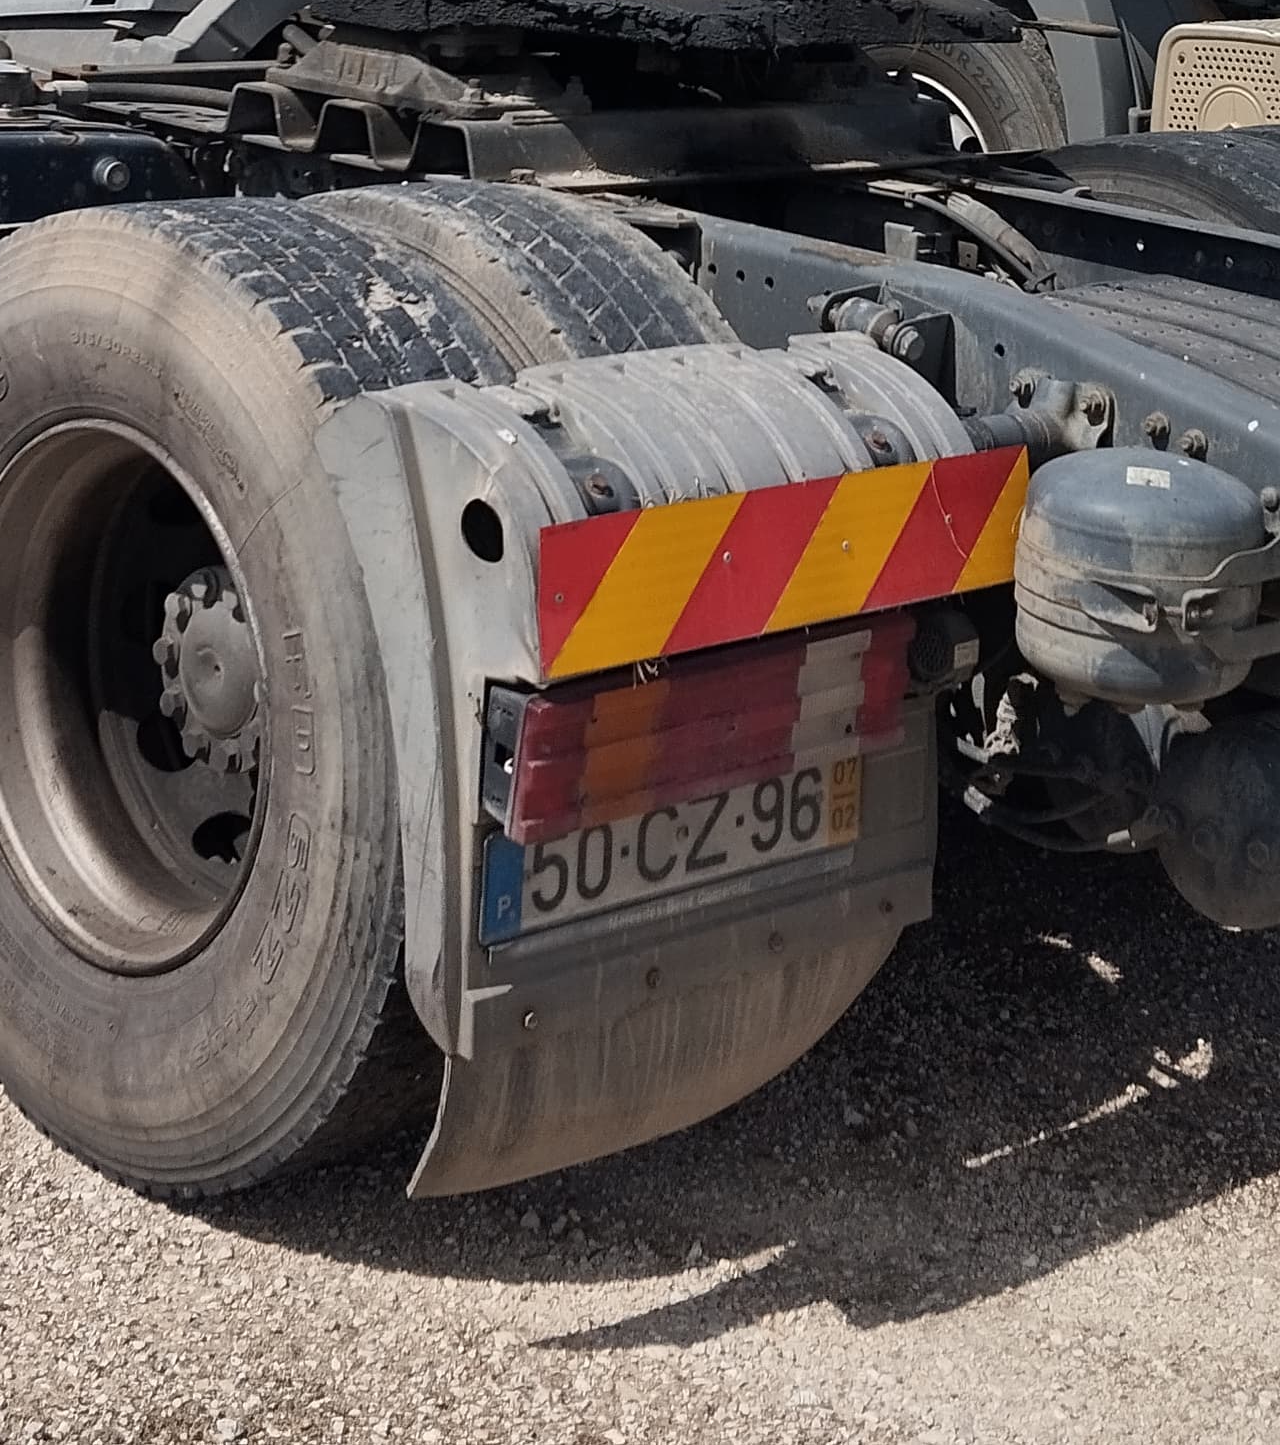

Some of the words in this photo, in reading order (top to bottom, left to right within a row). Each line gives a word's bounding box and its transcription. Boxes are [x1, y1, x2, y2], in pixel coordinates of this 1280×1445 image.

[832, 757, 858, 786] 07
[830, 805, 857, 833] 02
[496, 895, 512, 920] P
